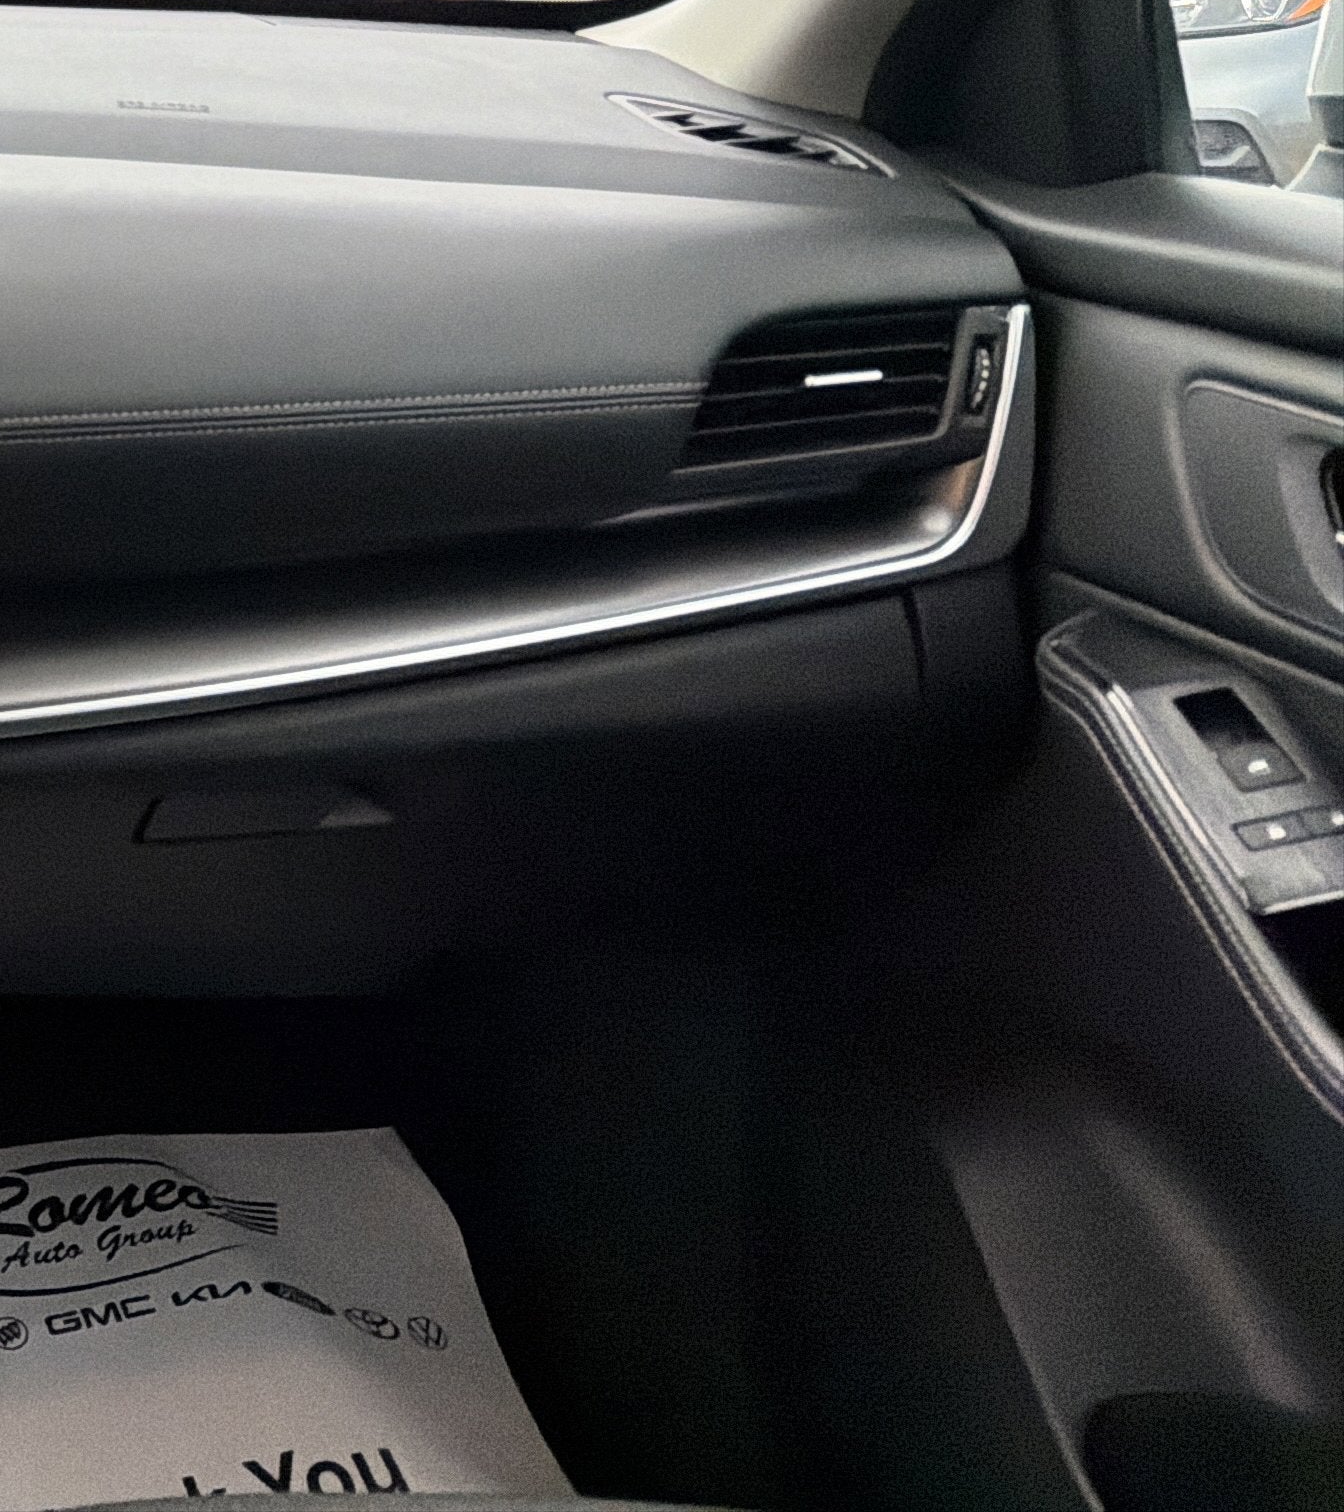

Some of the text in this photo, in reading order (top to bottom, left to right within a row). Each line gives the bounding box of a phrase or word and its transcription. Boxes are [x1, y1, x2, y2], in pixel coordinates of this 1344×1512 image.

[0, 1218, 197, 1274] Auto Group
[44, 1294, 157, 1336] GMC
